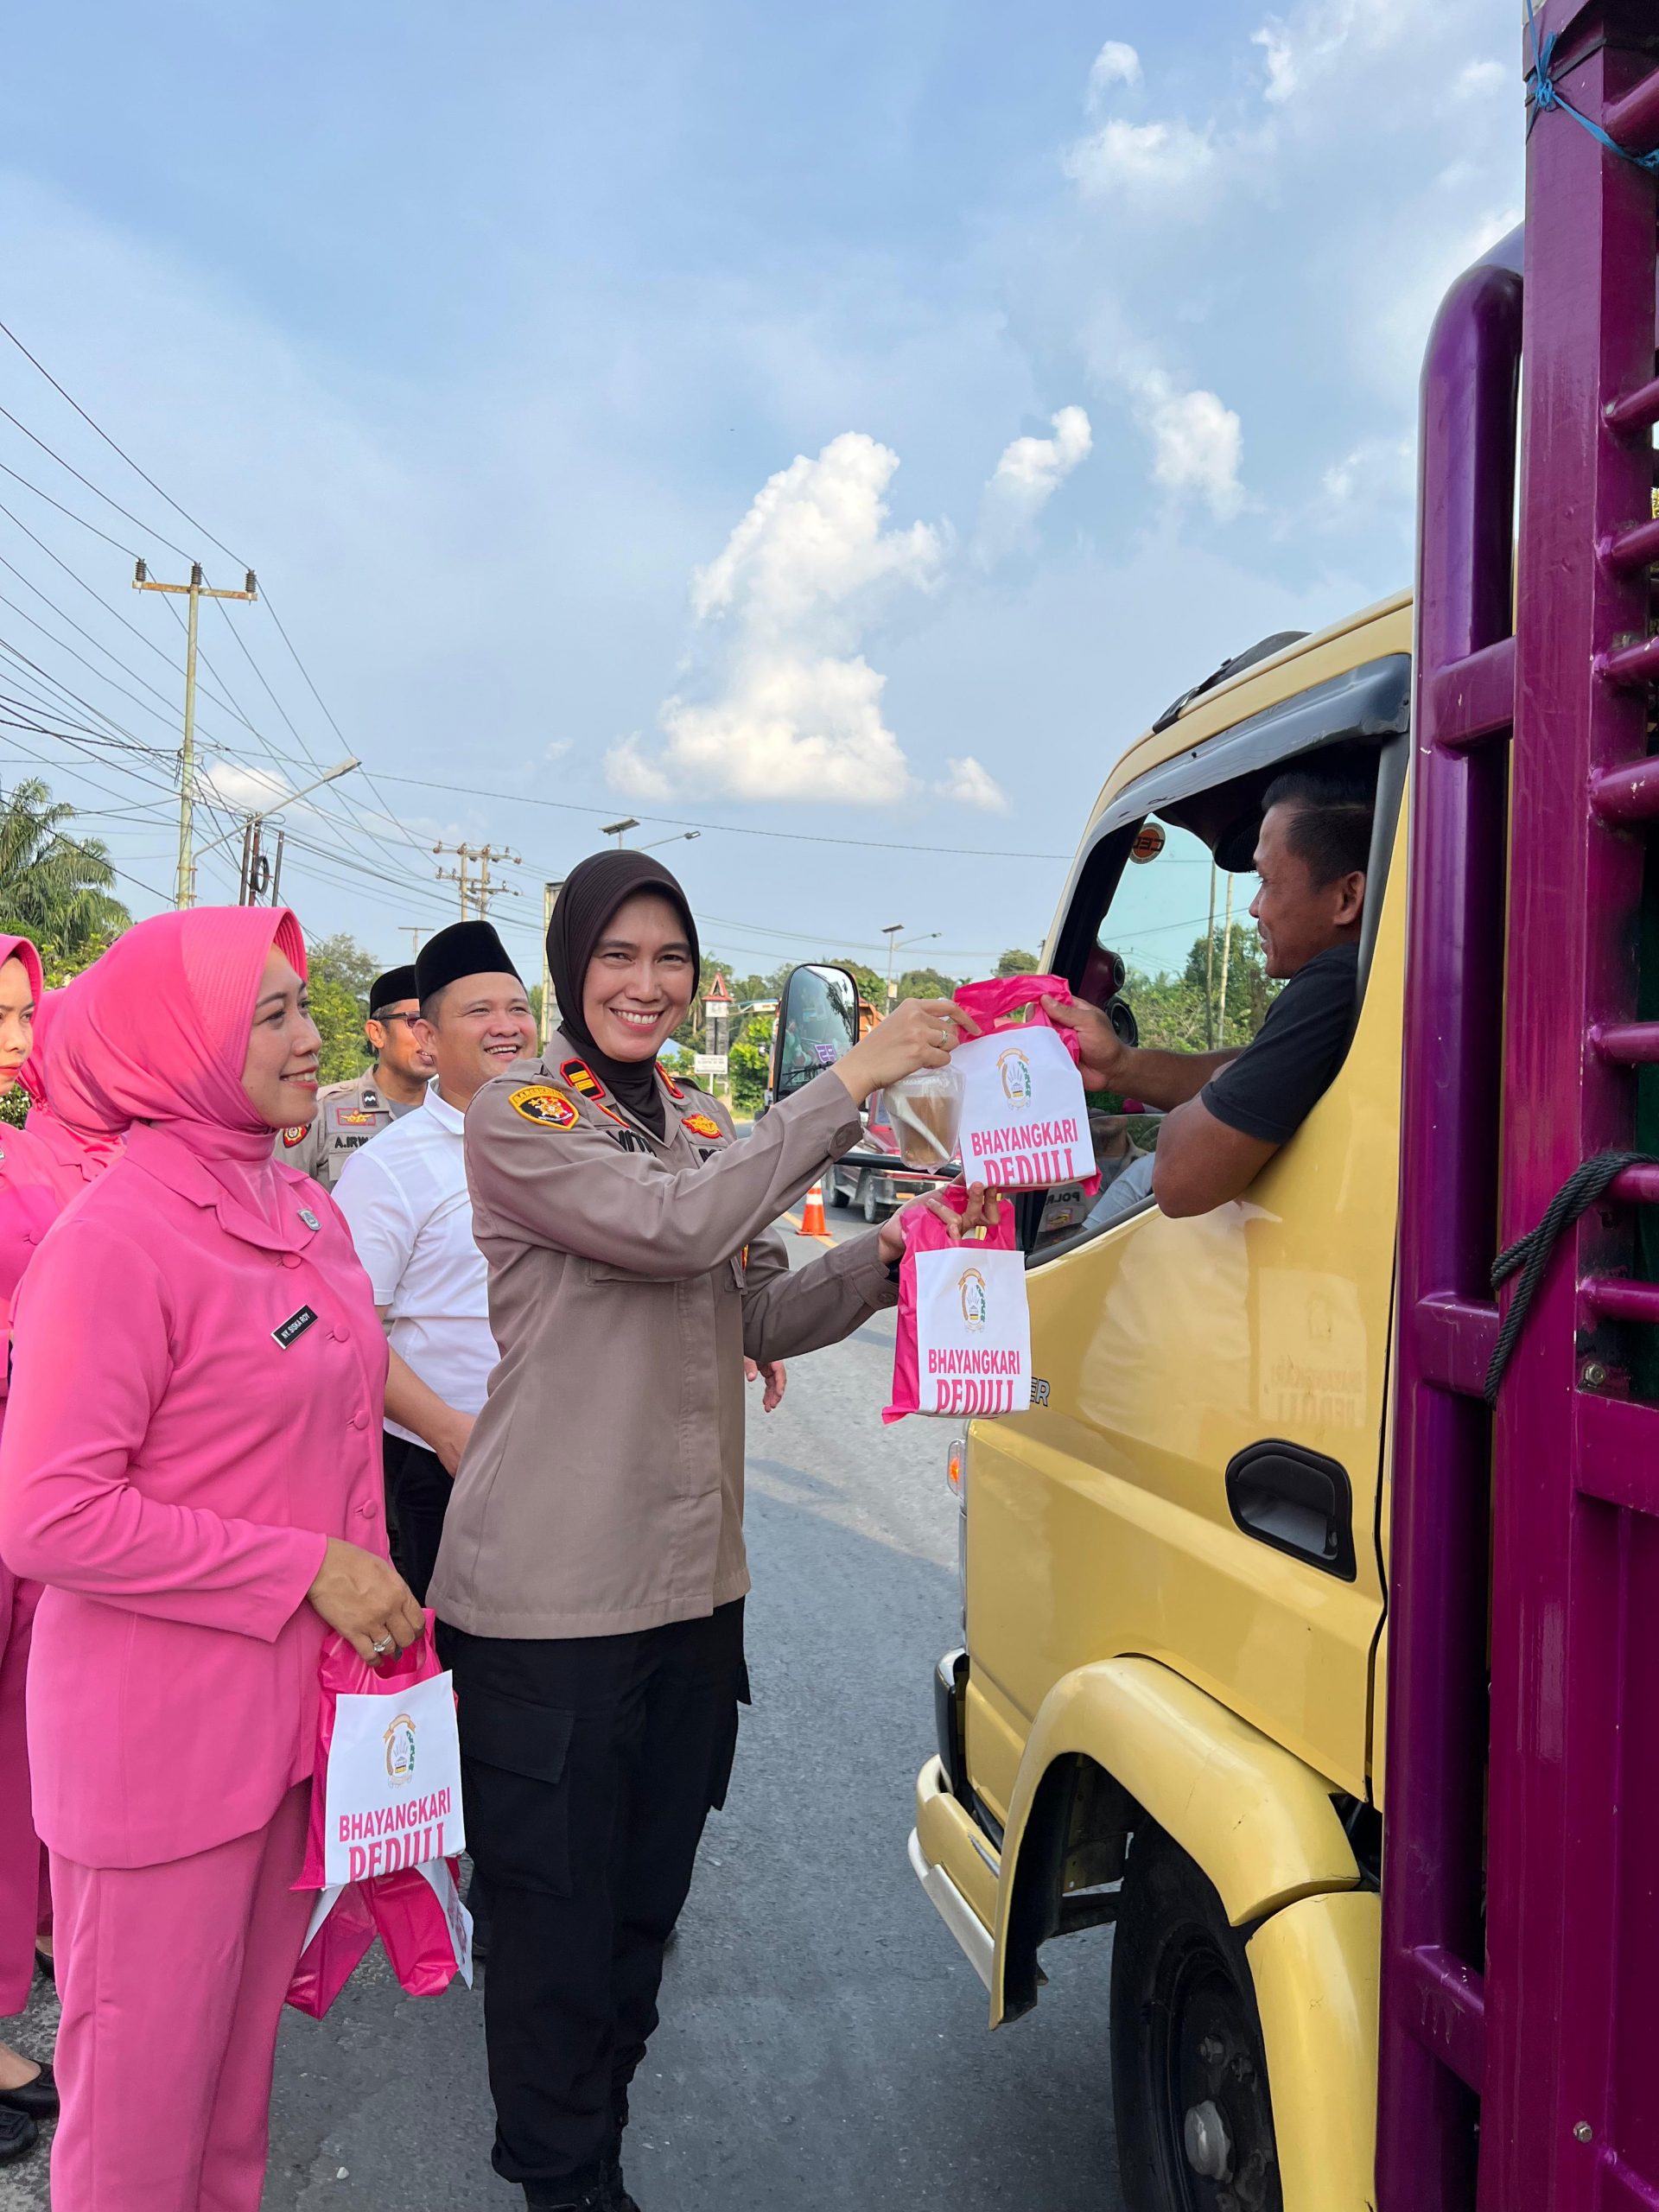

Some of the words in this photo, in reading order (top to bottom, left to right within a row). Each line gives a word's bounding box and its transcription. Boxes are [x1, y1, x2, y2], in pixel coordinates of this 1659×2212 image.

[971, 1118, 1078, 1156] BHAYANGKARI
[928, 1349, 1020, 1375] BHAYANGKARI
[340, 1787, 451, 1842] BHAYANGKARI
